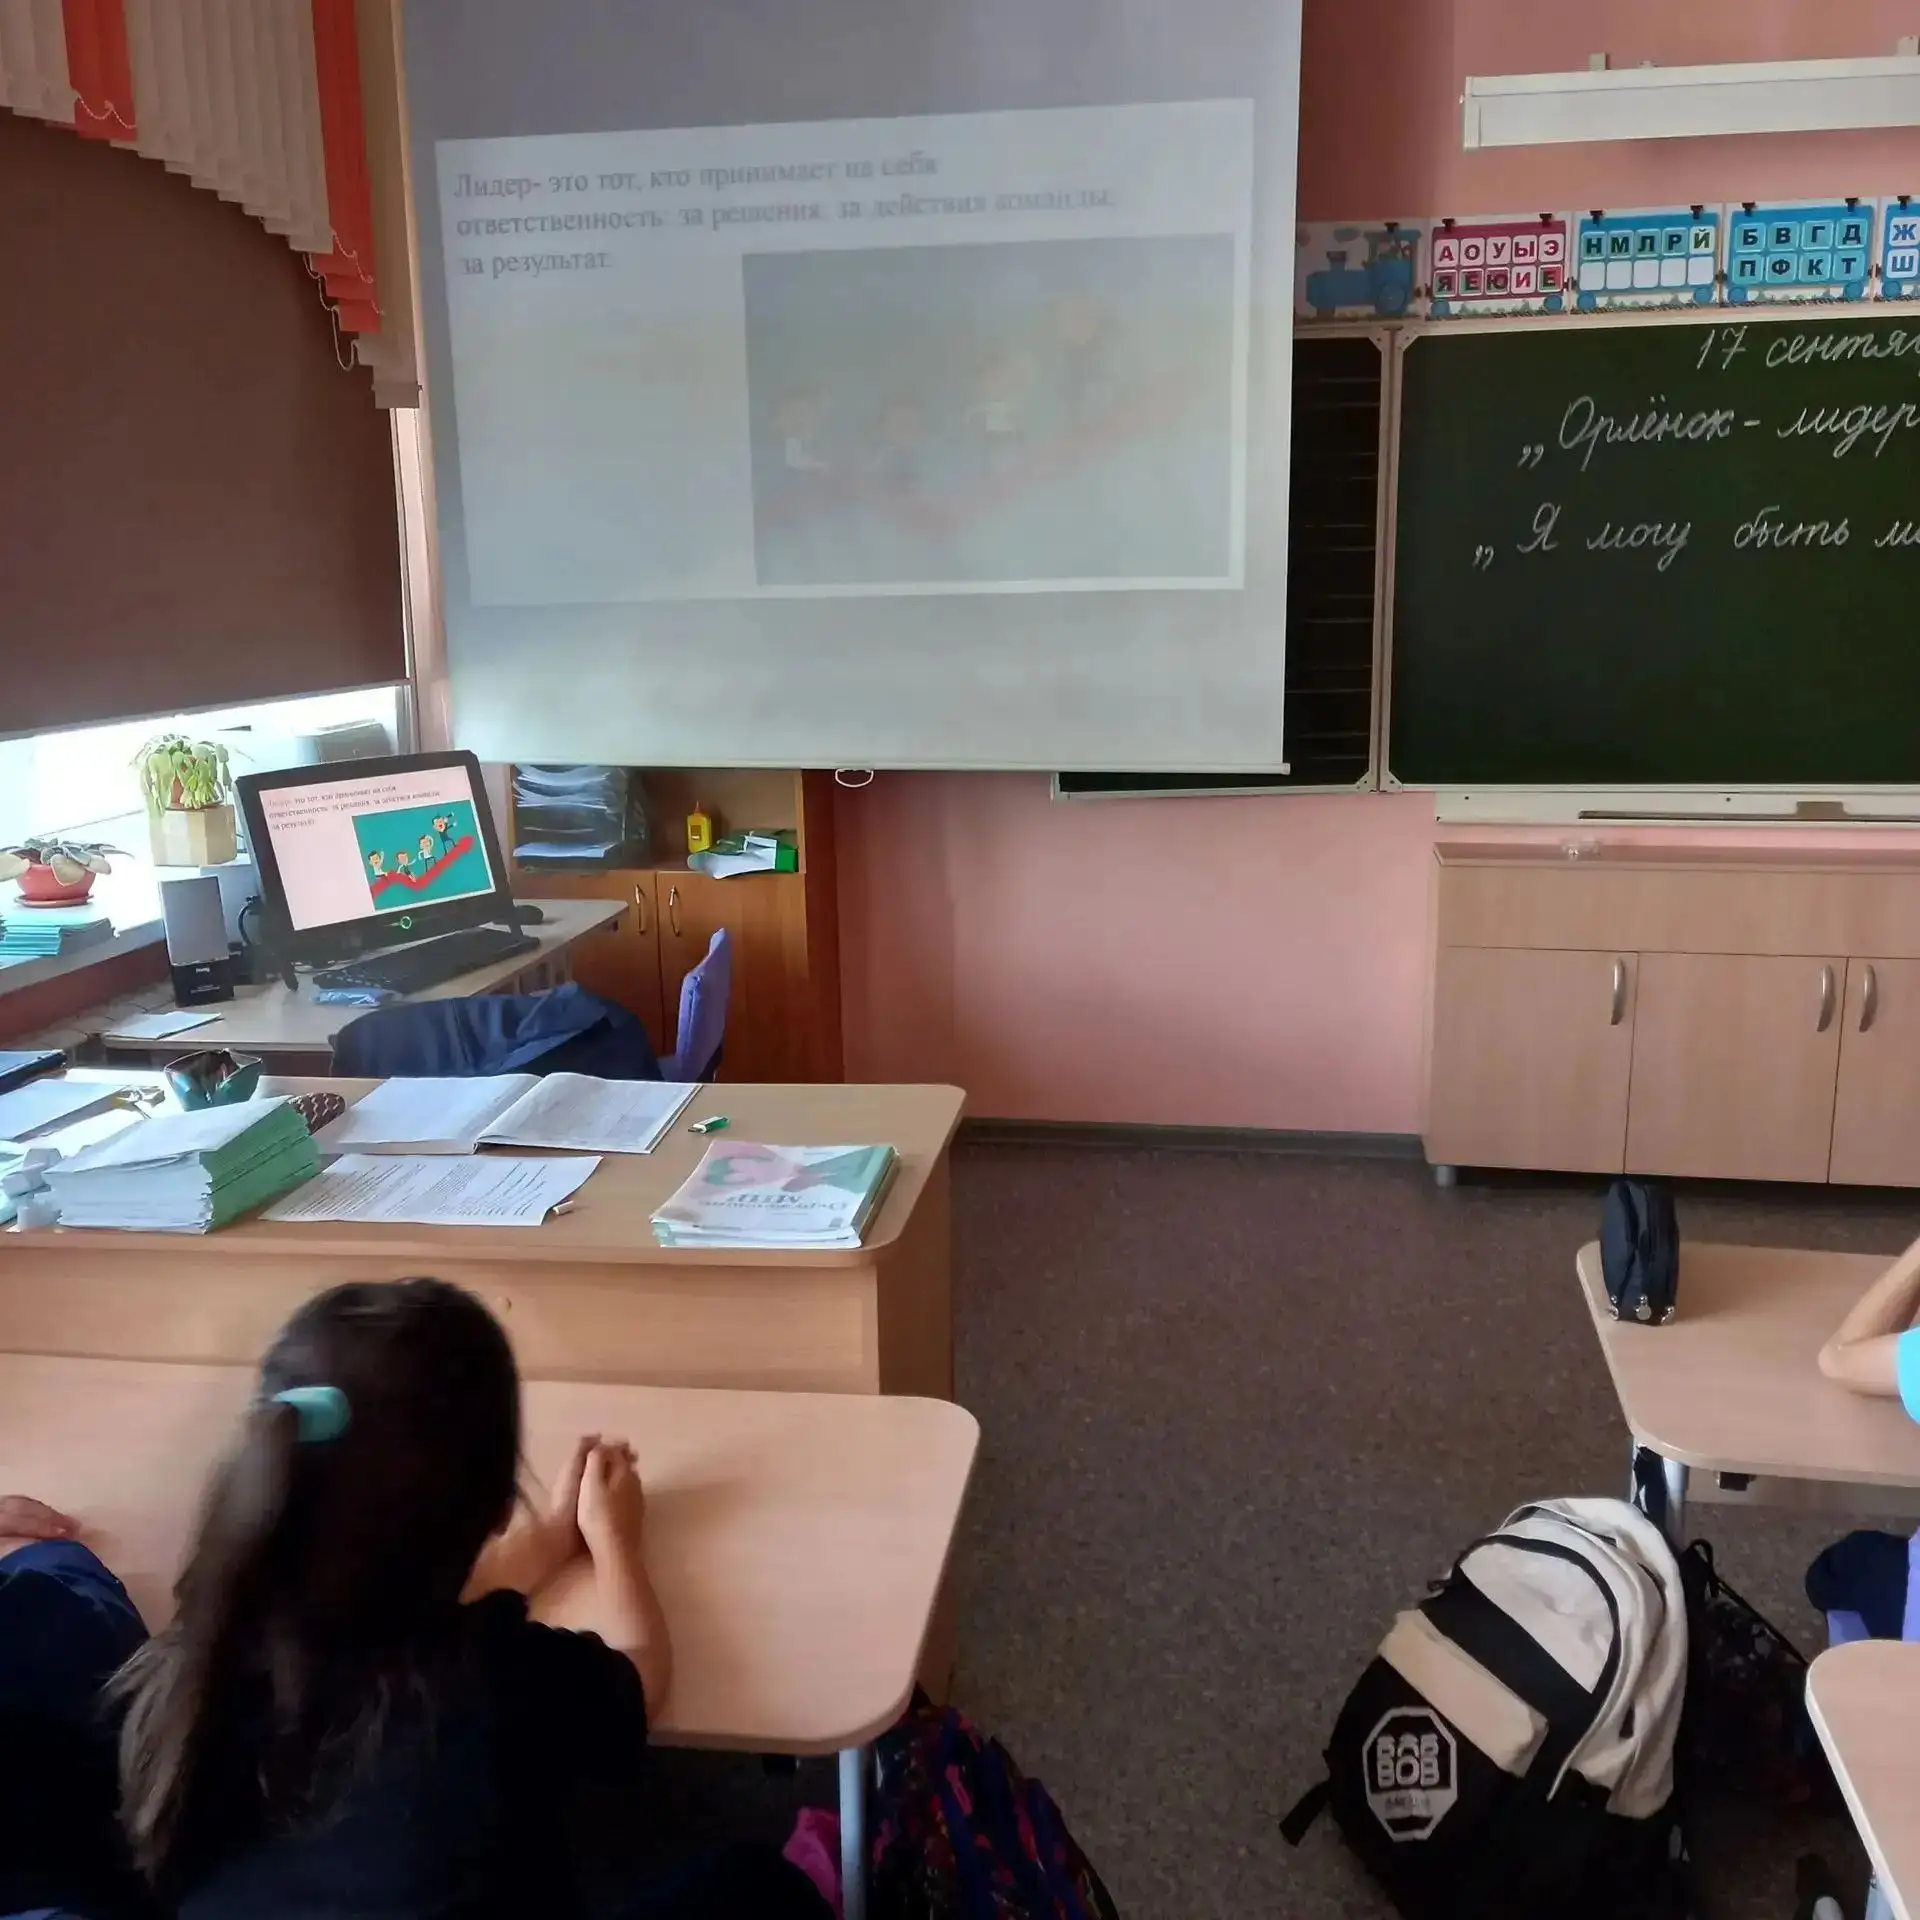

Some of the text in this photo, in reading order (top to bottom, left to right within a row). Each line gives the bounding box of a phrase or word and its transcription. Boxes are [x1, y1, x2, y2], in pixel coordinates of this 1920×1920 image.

[453, 173, 541, 201] Лидер-
[548, 173, 589, 193] это
[650, 169, 691, 189] кто
[700, 162, 837, 191] принимает
[678, 207, 704, 226] за
[1586, 228, 1710, 255] Н М Л Р Й
[1743, 223, 1861, 246] Б В Г Д
[1892, 223, 1917, 241] Ж
[1438, 239, 1560, 262] А О У Ы Э
[460, 256, 484, 275] за
[1739, 257, 1857, 277] П Ф К Т
[1891, 255, 1915, 272] Ш
[1515, 271, 1531, 288] И
[1696, 325, 1748, 370] 17
[1777, 402, 1920, 459] лидер
[1586, 520, 1692, 572] могу
[1733, 504, 1850, 549] быть
[1377, 1755, 1440, 1789] BOB
